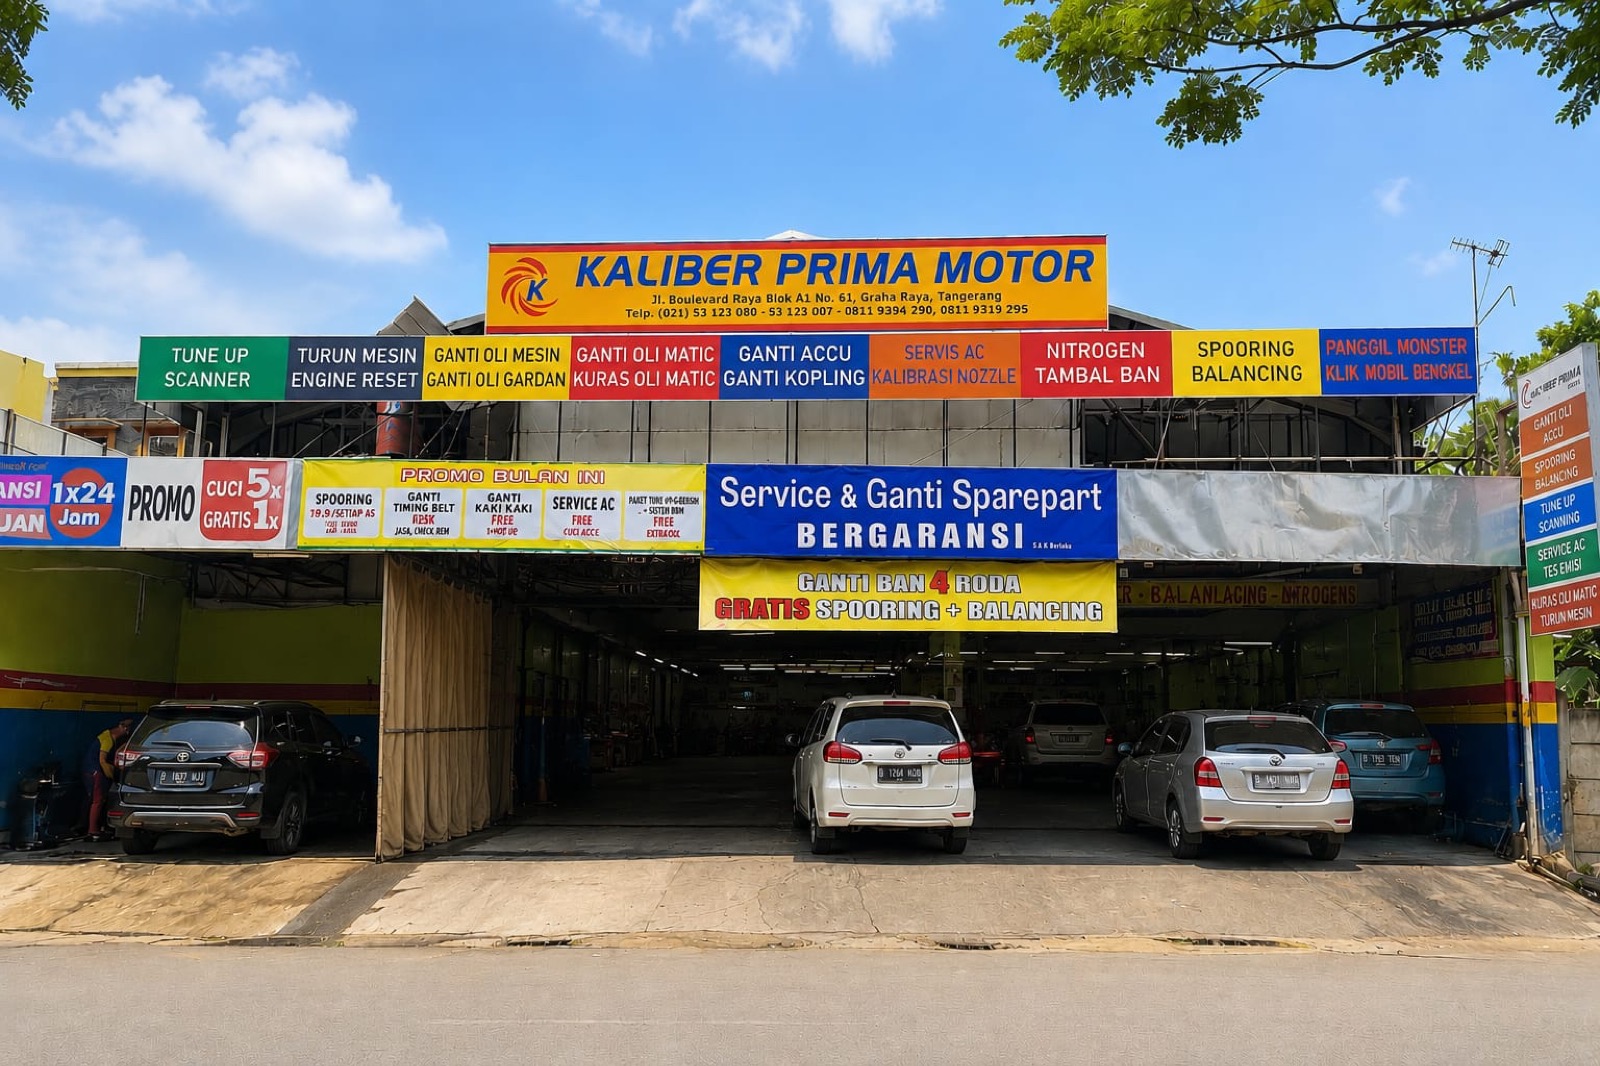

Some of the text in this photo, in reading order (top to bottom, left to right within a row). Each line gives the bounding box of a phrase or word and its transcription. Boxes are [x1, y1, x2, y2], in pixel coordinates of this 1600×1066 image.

[576, 250, 1095, 287] KALIBER PRIMA MOTOR
[651, 291, 1002, 307] Jl. Boulevard Raya Blok A1 No. 61, Graha Raya, Tangerang
[626, 308, 654, 319] Telp.
[658, 308, 689, 320] (021)
[693, 308, 707, 318] 53
[711, 308, 732, 317] 123
[736, 308, 757, 317] 080
[769, 307, 783, 317] 53
[787, 307, 808, 317] 123
[812, 306, 834, 316] 007
[844, 306, 874, 316] 0811
[877, 306, 907, 315] 9394
[911, 305, 936, 317] 290,
[940, 305, 969, 315] 0811
[973, 305, 1002, 315] 9319
[1006, 304, 1028, 314] 295
[434, 347, 560, 362] GANTI OLI MESIN
[576, 346, 715, 363] GANTI OLI MATIC
[739, 345, 851, 362] GANTI ACCU
[904, 344, 985, 360] SERVIS AC
[1046, 341, 1145, 359] NITROGEN
[1197, 340, 1294, 358] SPOORING
[1326, 338, 1468, 356] PANGGIL MONSTER
[171, 348, 249, 364] TUNE UP
[297, 348, 417, 364] TURUN MESIN
[164, 371, 251, 388] SCANNER
[291, 371, 418, 388] ENGINE RESET
[426, 372, 566, 387] GANTI OLI GARDAN
[573, 370, 716, 387] KURAS OLI MATIC
[723, 369, 866, 386] GANTI KOPLING
[872, 368, 1016, 385] KALIBRASI NOZZLE
[1034, 365, 1160, 384] TAMBAL BAN
[1192, 365, 1303, 382] BALANCING
[1325, 363, 1472, 381] KLIK MOBIL BENGKEL
[1533, 408, 1573, 431] GANTI OLI
[1543, 424, 1564, 445] ACCU
[1534, 448, 1576, 475] SPOORING
[400, 468, 606, 485] PROMO BULAN INI
[1534, 467, 1579, 492] BALANCING
[52, 481, 116, 504] 1x24
[206, 479, 243, 497] CUCI
[407, 491, 441, 502] GANTI
[128, 485, 196, 522] PROMO
[315, 493, 373, 506] SPOORING
[487, 492, 521, 503] GANTI
[552, 496, 615, 511] SERVICE AC
[719, 476, 1103, 518] Service & Ganti Sparepart
[1540, 493, 1576, 515] TUNE UP
[393, 503, 455, 513] TIMING BELT
[475, 503, 533, 513] KAKI KAKI
[58, 508, 100, 526] Jam
[203, 510, 251, 529] GRATIS
[491, 514, 514, 525] FREE
[572, 514, 592, 526] FREE
[653, 516, 674, 527] FREE
[1537, 514, 1580, 533] SCANNING
[797, 522, 1024, 549] BERGARANSI
[1537, 536, 1586, 562] SERVICE AC
[1543, 556, 1582, 578] TES EMISI
[797, 569, 1021, 595] GANTI BAN 4 RODA
[1531, 584, 1598, 610] KURAS OLI MATIC
[714, 597, 1103, 622] GRATIS SPOORING + BALANCING
[1539, 604, 1593, 627] TURUN MESIN
